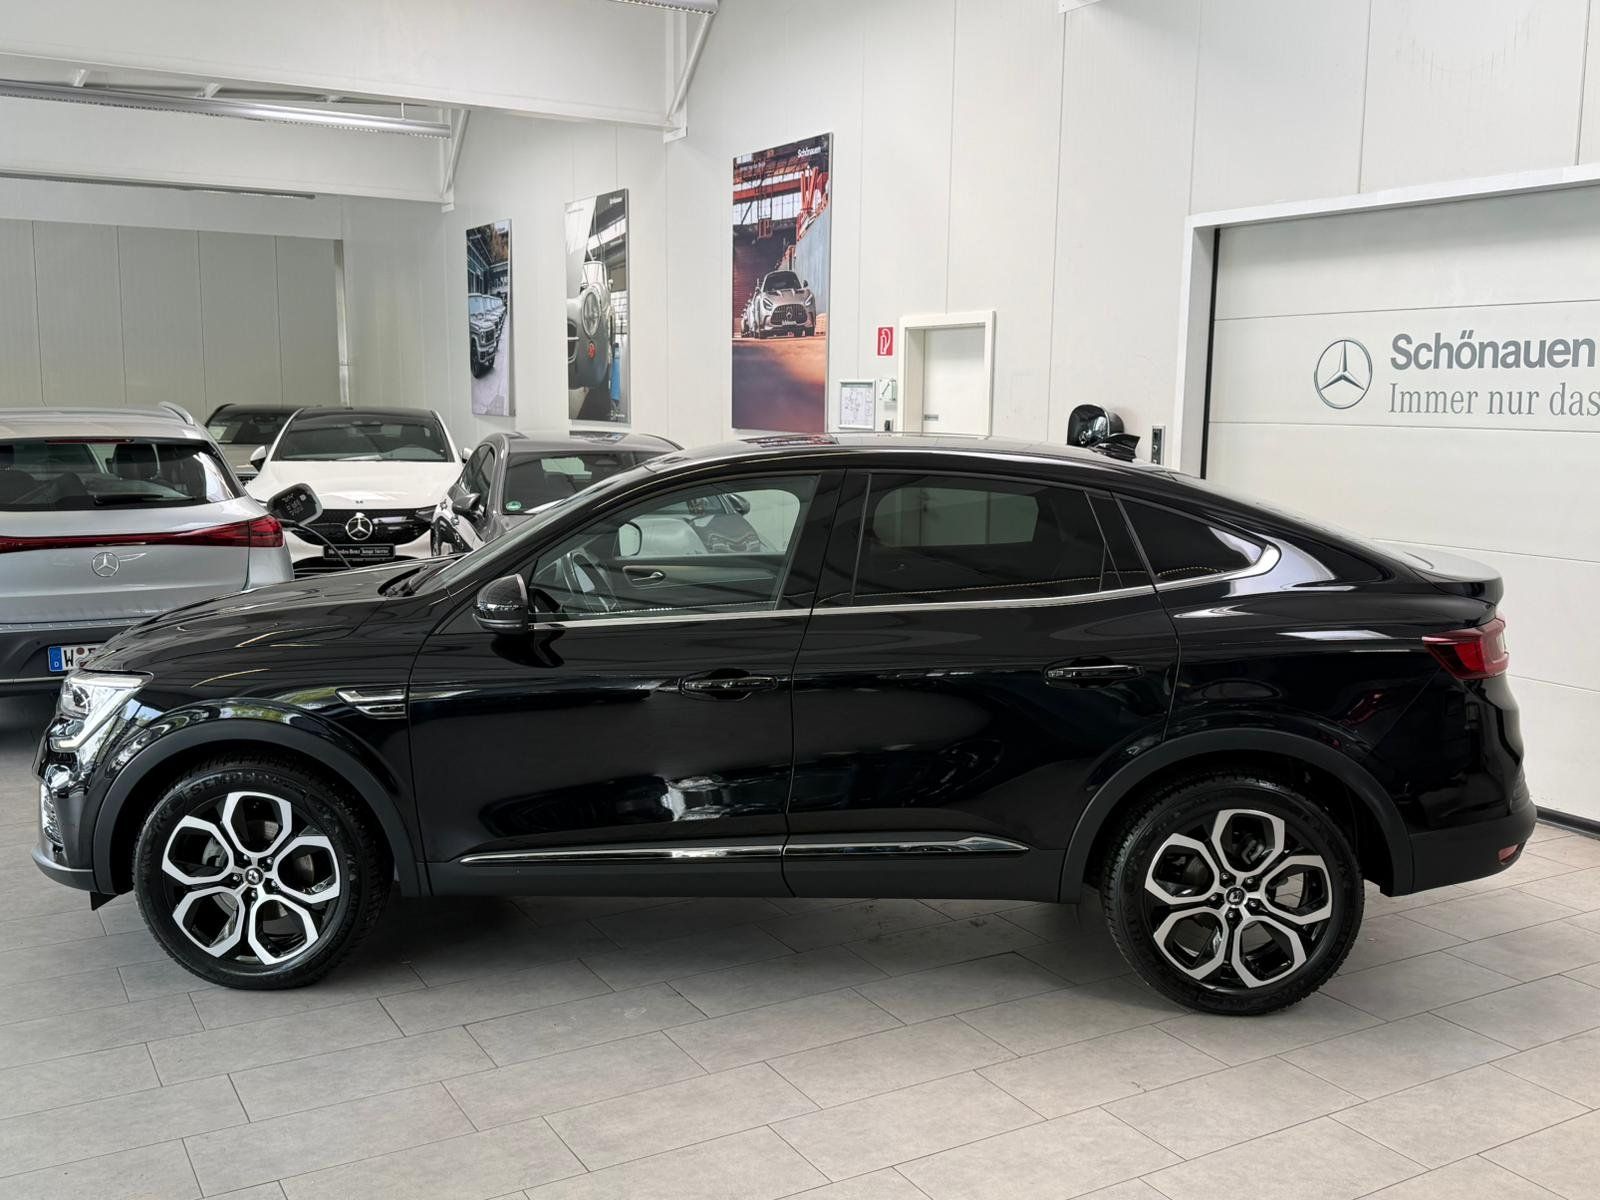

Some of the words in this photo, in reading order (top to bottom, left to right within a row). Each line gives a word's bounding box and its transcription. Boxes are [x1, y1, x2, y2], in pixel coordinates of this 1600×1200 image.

[1390, 329, 1596, 370] Schönauen
[1388, 382, 1478, 414] Immer
[1487, 390, 1539, 415] nur
[1549, 382, 1600, 416] das
[64, 649, 73, 667] W
